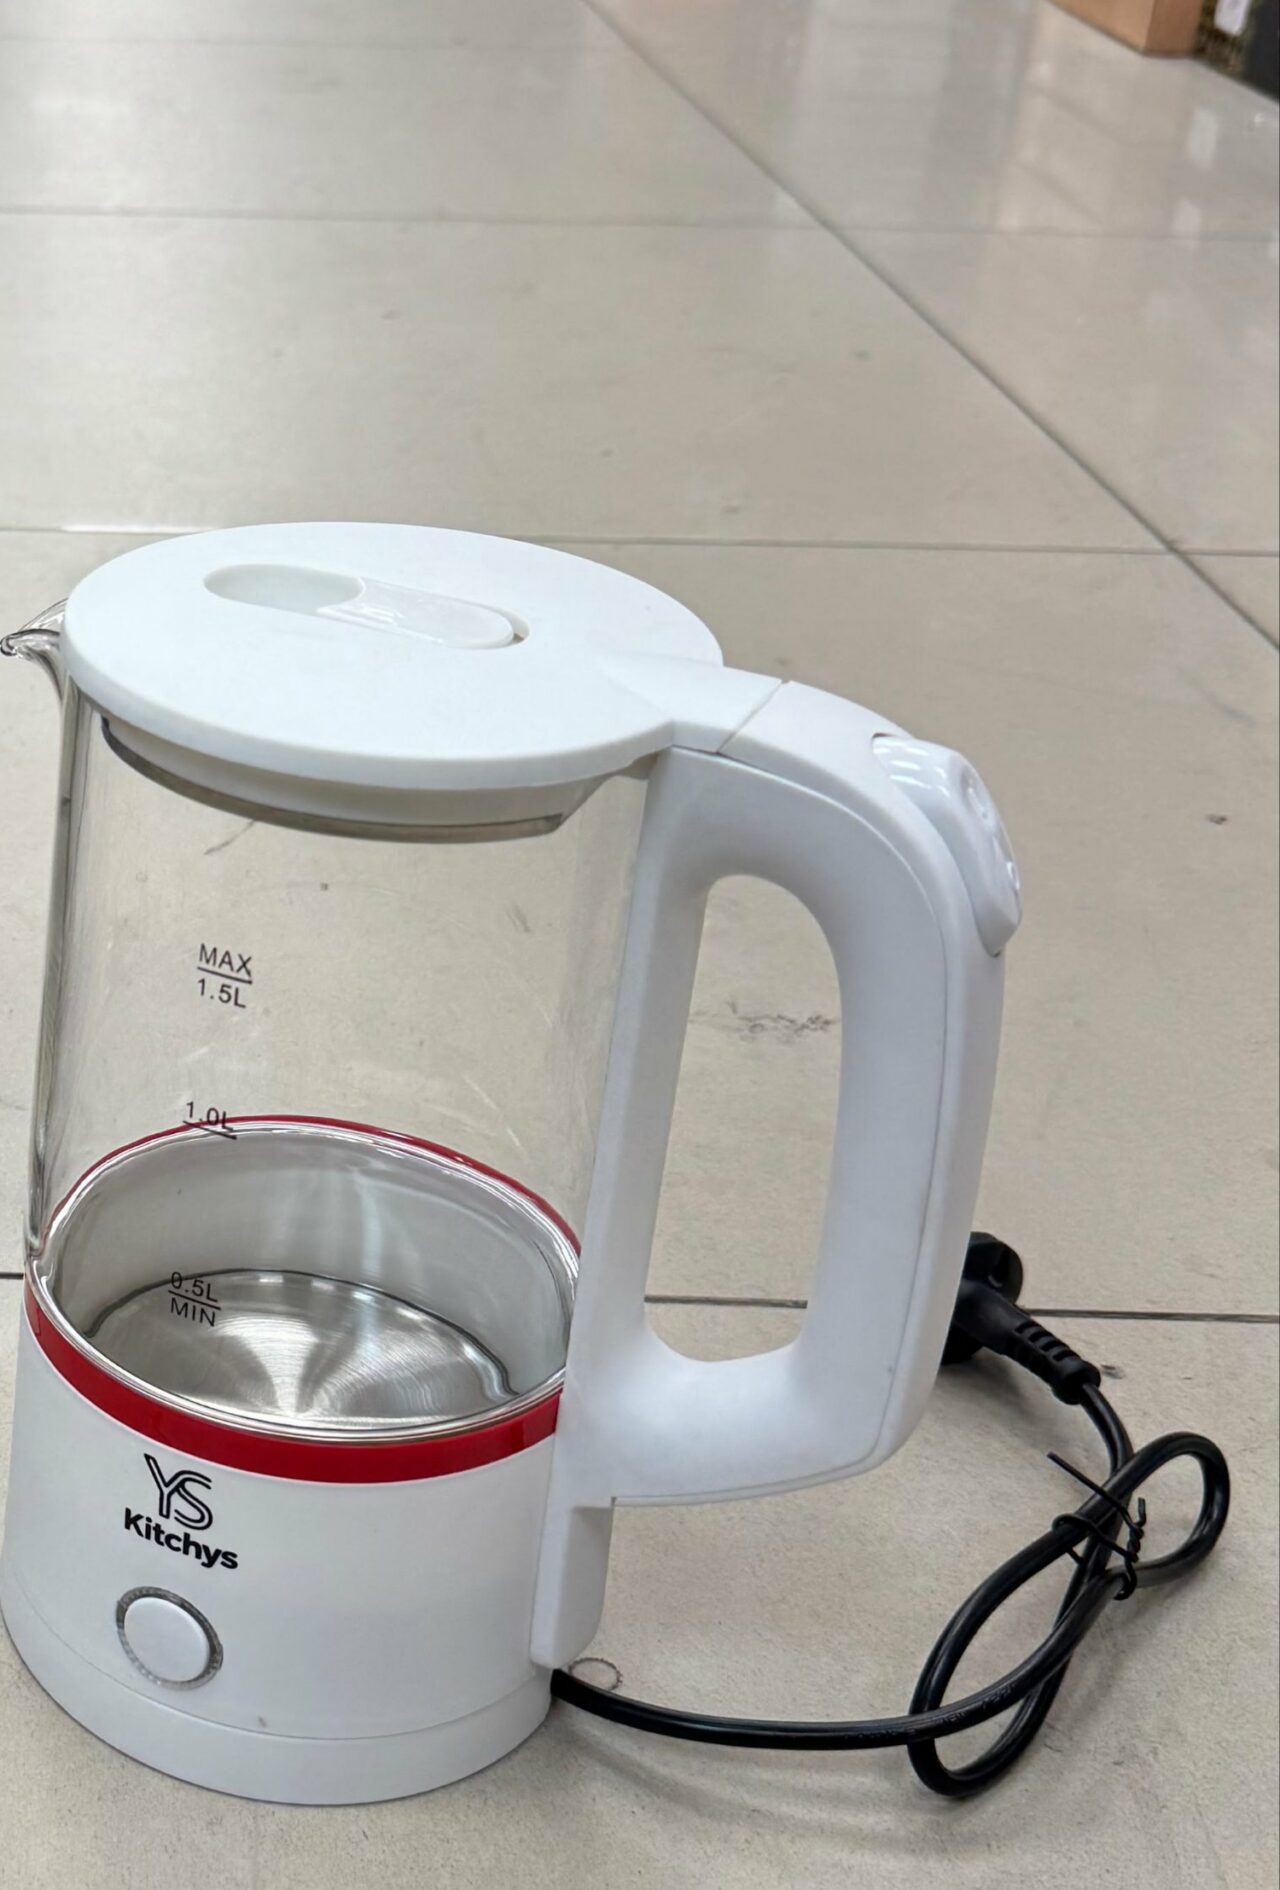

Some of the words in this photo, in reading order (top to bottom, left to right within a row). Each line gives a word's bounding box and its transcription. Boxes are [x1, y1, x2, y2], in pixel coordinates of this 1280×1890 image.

[199, 943, 252, 978] MAX
[197, 978, 247, 1009] 1.5L
[186, 1101, 234, 1132] 1.0L
[171, 1271, 218, 1303] 0.5L
[170, 1297, 216, 1327] MIN
[143, 1453, 213, 1530] YS
[123, 1507, 239, 1569] Kitchys
